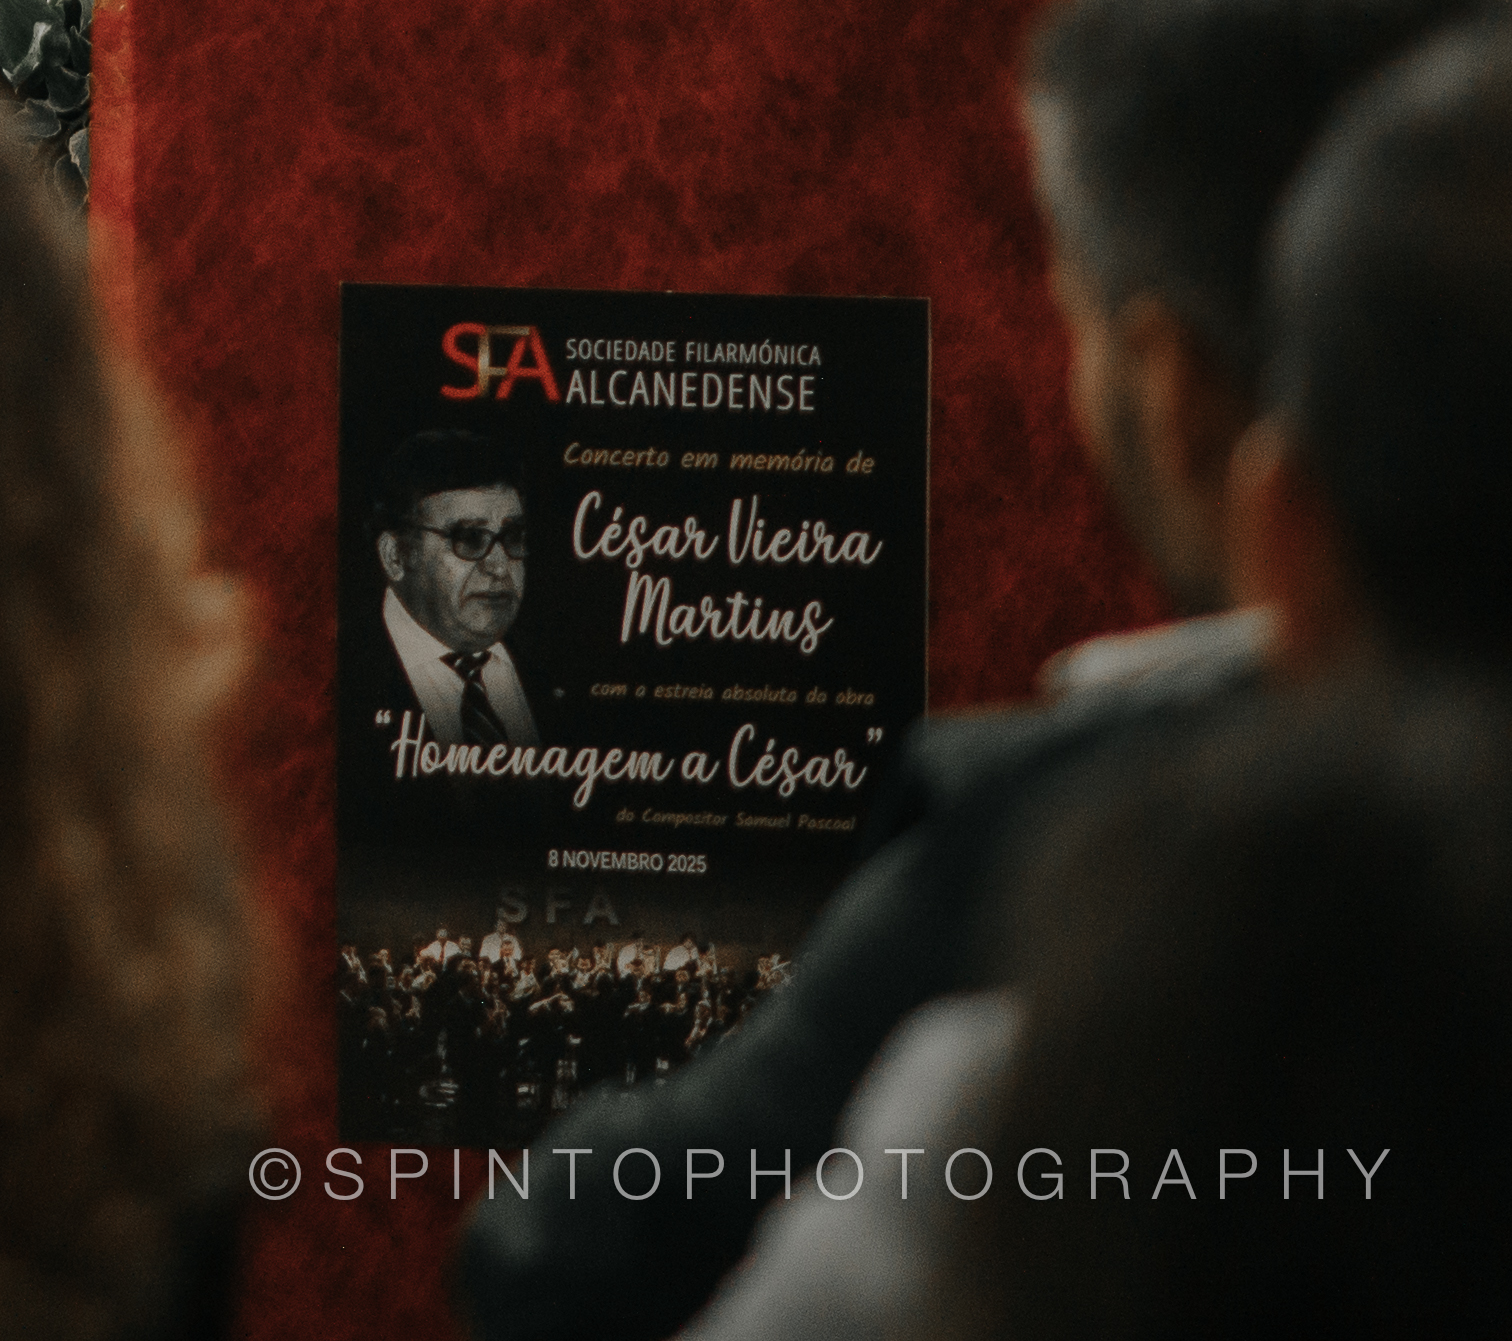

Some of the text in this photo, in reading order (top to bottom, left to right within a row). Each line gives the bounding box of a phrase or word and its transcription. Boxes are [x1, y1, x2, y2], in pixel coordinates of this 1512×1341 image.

[440, 321, 561, 401] SFA
[565, 337, 822, 367] SOCIEDADE FILARMÓNICA
[565, 369, 814, 412] ALCANEDENSE
[562, 441, 876, 475] Concerto em memória de
[572, 489, 883, 568] César Vieira
[620, 570, 833, 654] Martins
[590, 683, 628, 697] com
[633, 684, 648, 699] a
[652, 683, 715, 701] estreia
[720, 684, 798, 704] absoluta
[835, 688, 875, 706] obra
[680, 750, 720, 784] a
[641, 807, 728, 828] Compositor
[735, 811, 791, 829] Samuel
[547, 848, 708, 874] 8 NOVEMBRO 2025
